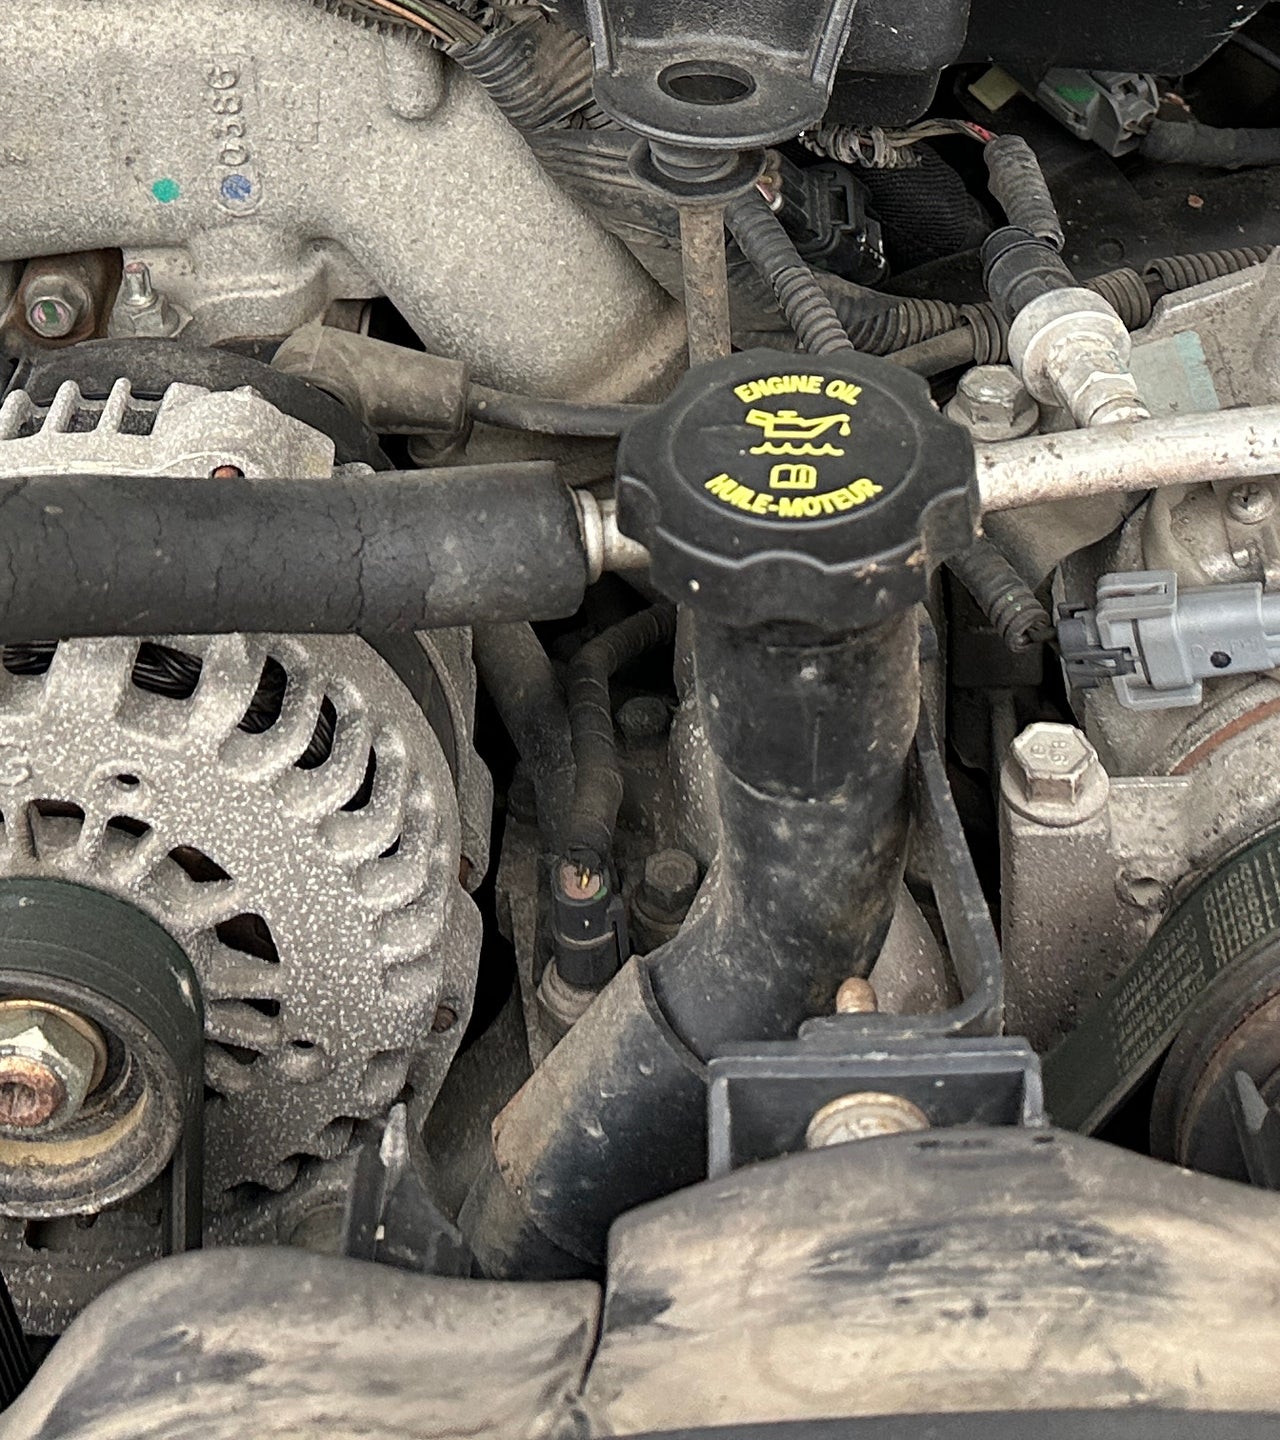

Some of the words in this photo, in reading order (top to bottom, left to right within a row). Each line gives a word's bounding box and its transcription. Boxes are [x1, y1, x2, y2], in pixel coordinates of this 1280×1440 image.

[734, 375, 825, 404] ENGINE
[825, 379, 864, 406] OIL
[704, 473, 884, 518] HUILE-MOTEUR
